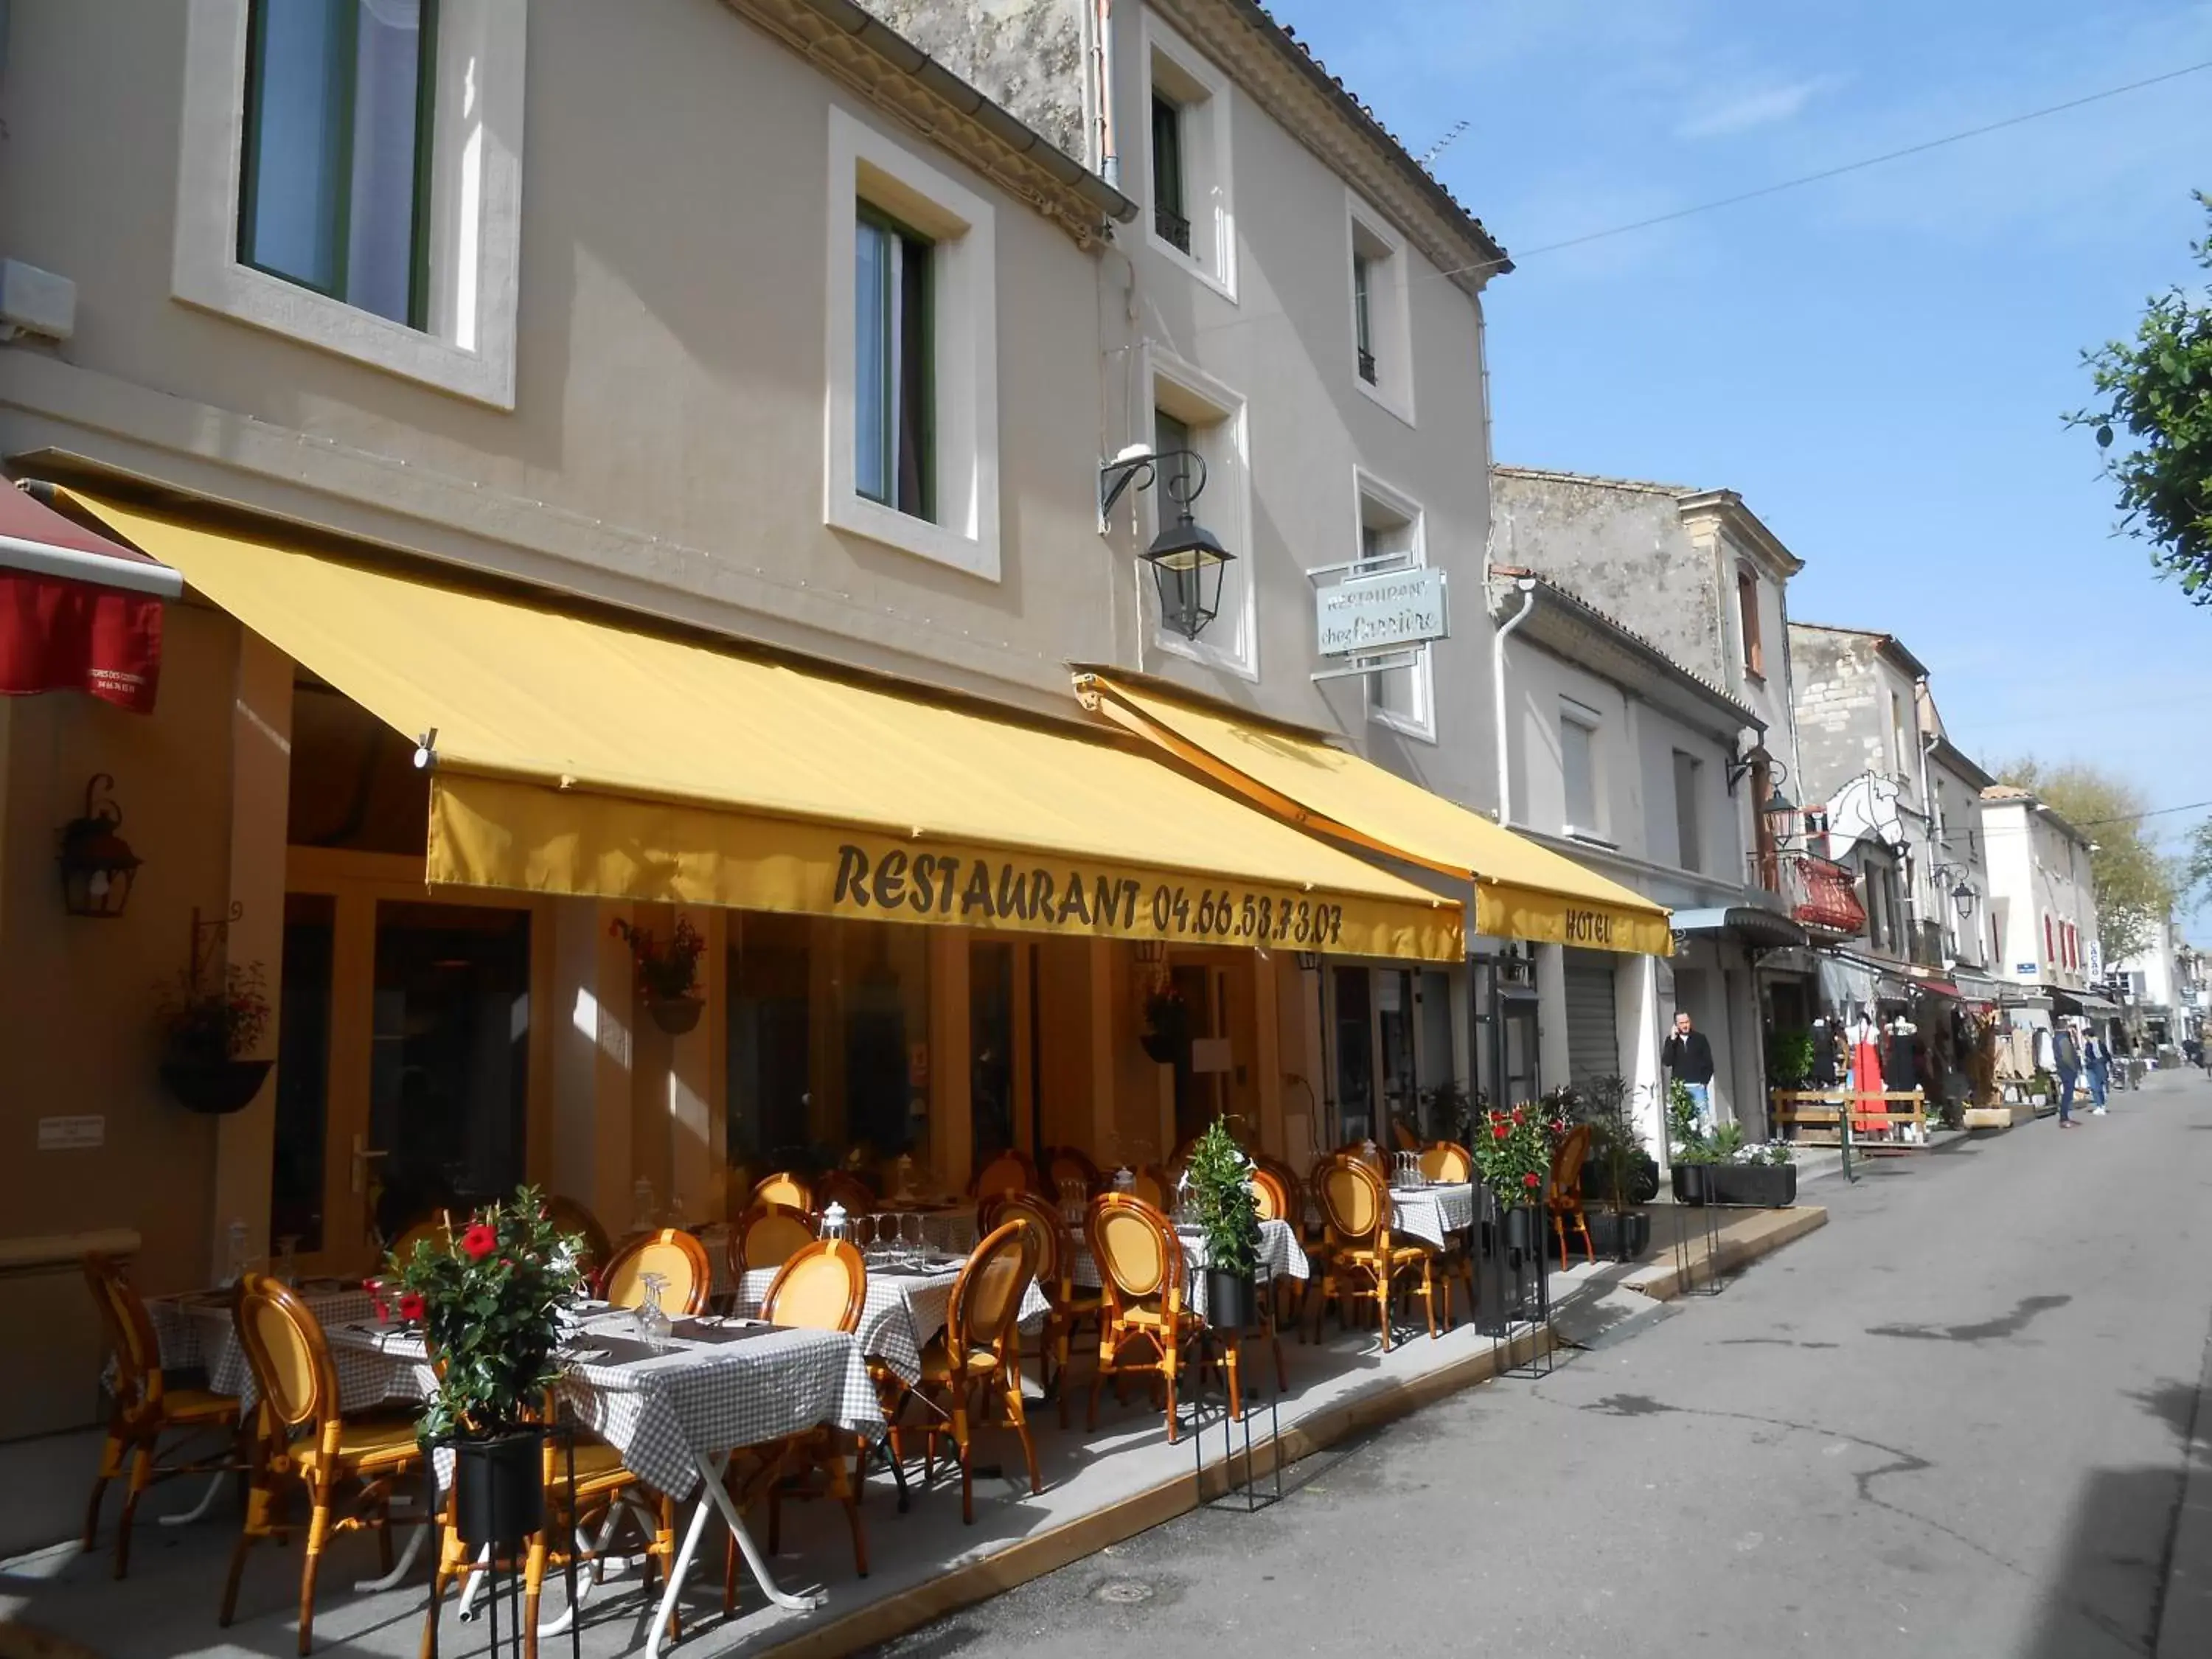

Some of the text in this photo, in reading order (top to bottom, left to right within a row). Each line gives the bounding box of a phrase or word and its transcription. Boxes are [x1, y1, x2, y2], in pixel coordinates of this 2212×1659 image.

[834, 844, 1342, 945] RESTAURANT 04.66.53.73.07
[1565, 907, 1611, 944] HOTEL
